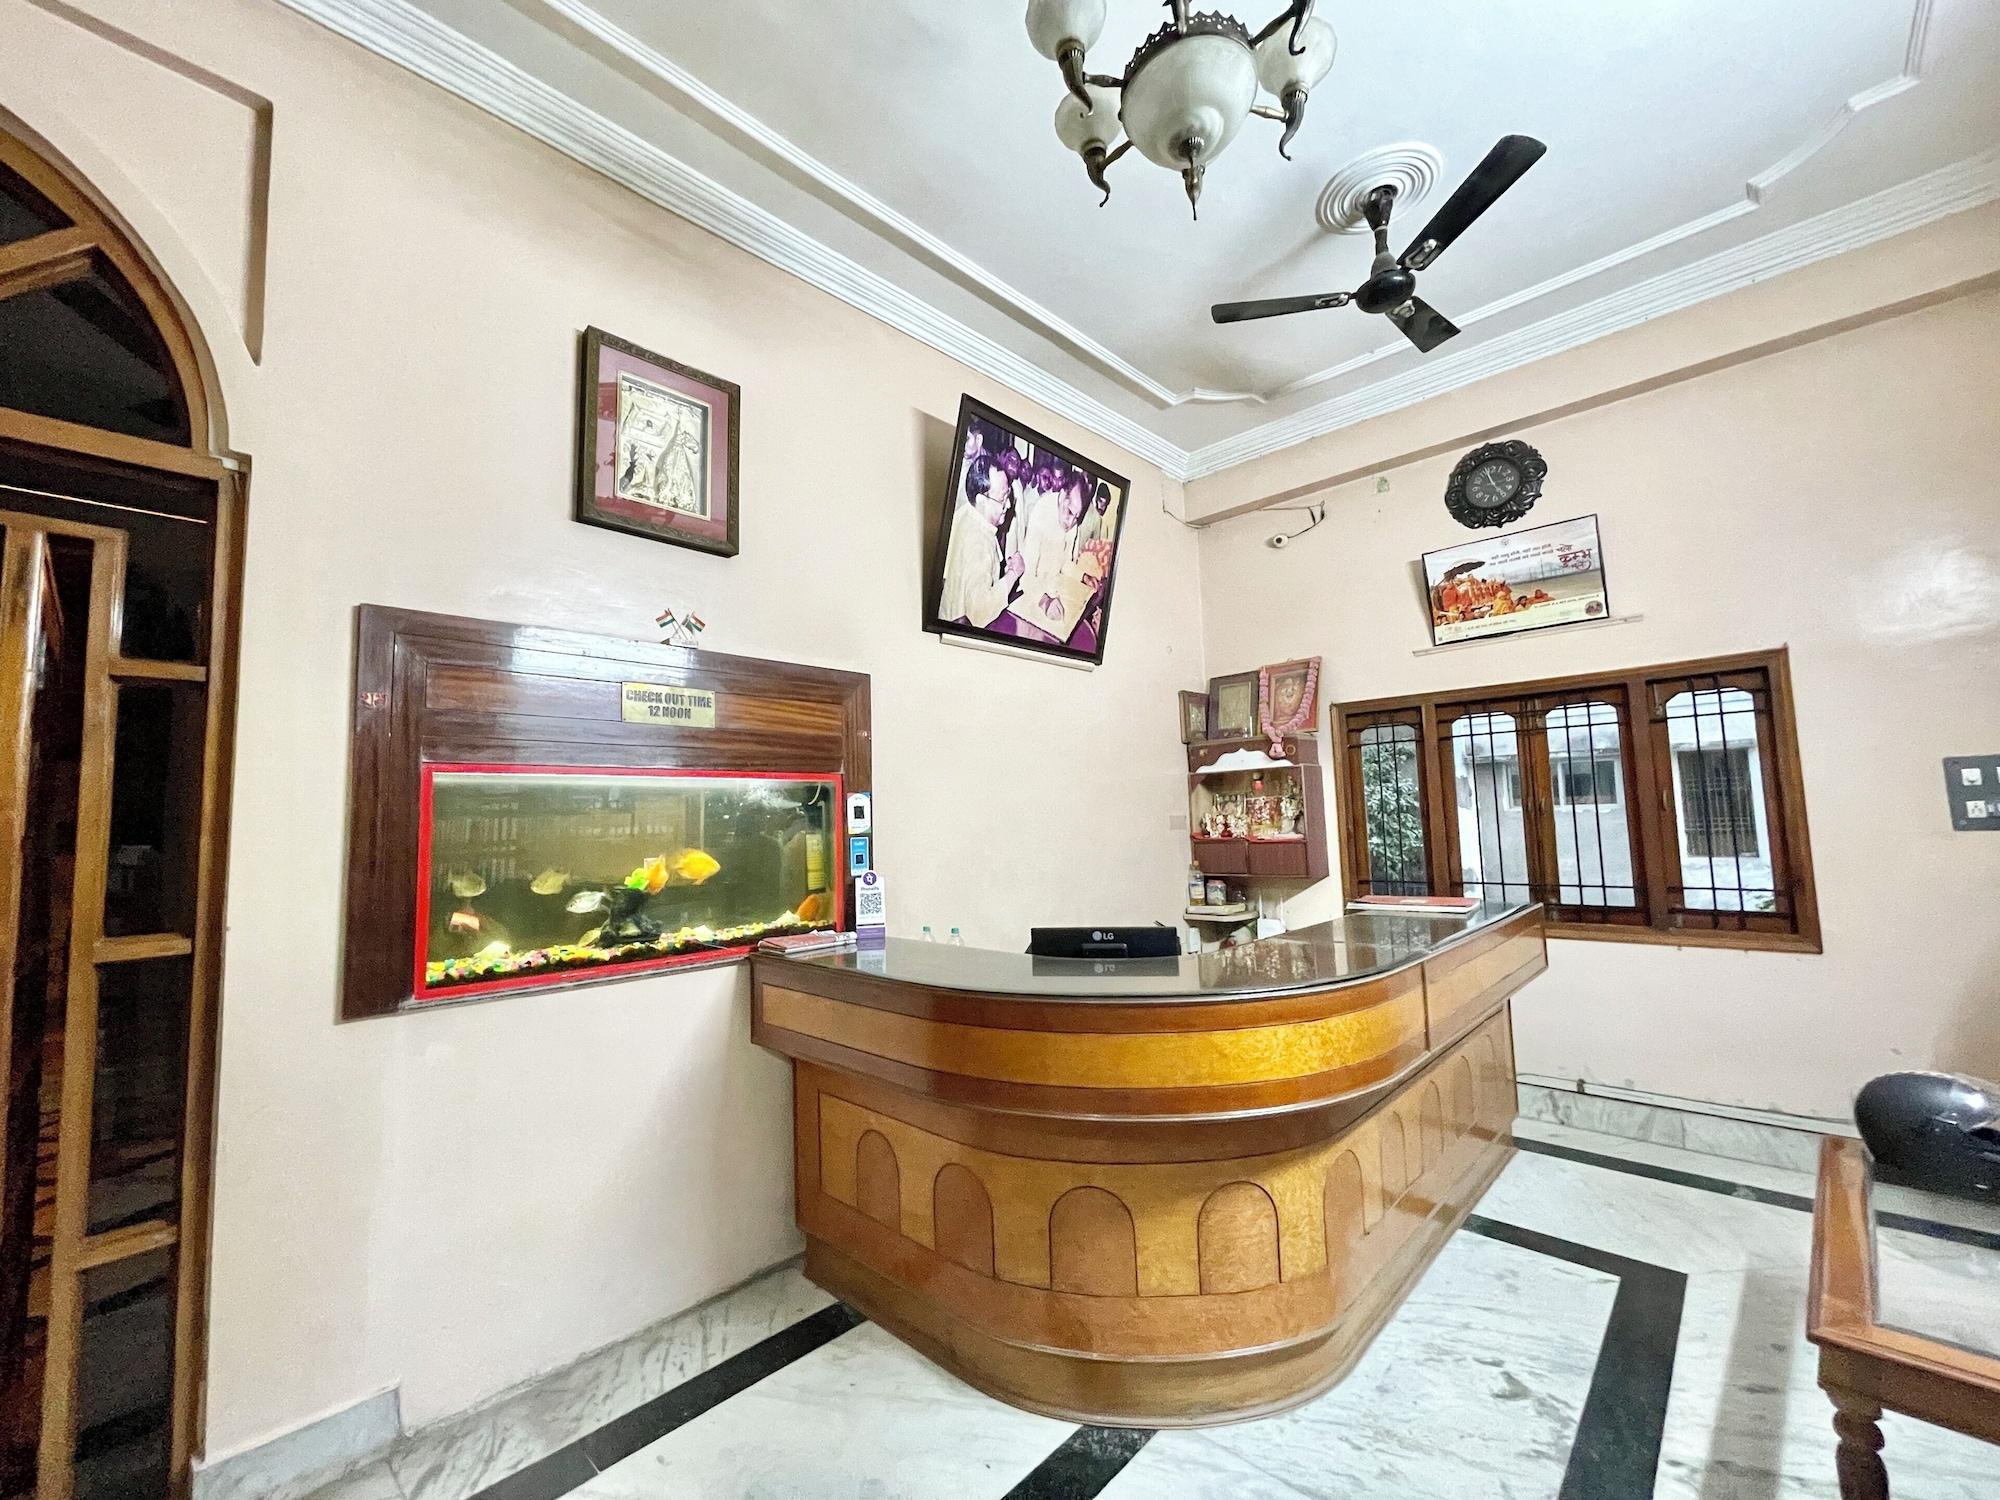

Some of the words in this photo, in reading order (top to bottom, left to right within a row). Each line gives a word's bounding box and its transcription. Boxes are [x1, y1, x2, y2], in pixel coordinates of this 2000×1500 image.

[626, 689, 663, 703] CHECK
[665, 693, 686, 706] OUT
[688, 695, 712, 708] TIME
[648, 705, 660, 717] 12
[662, 706, 691, 719] NOON
[1103, 932, 1114, 940] LG
